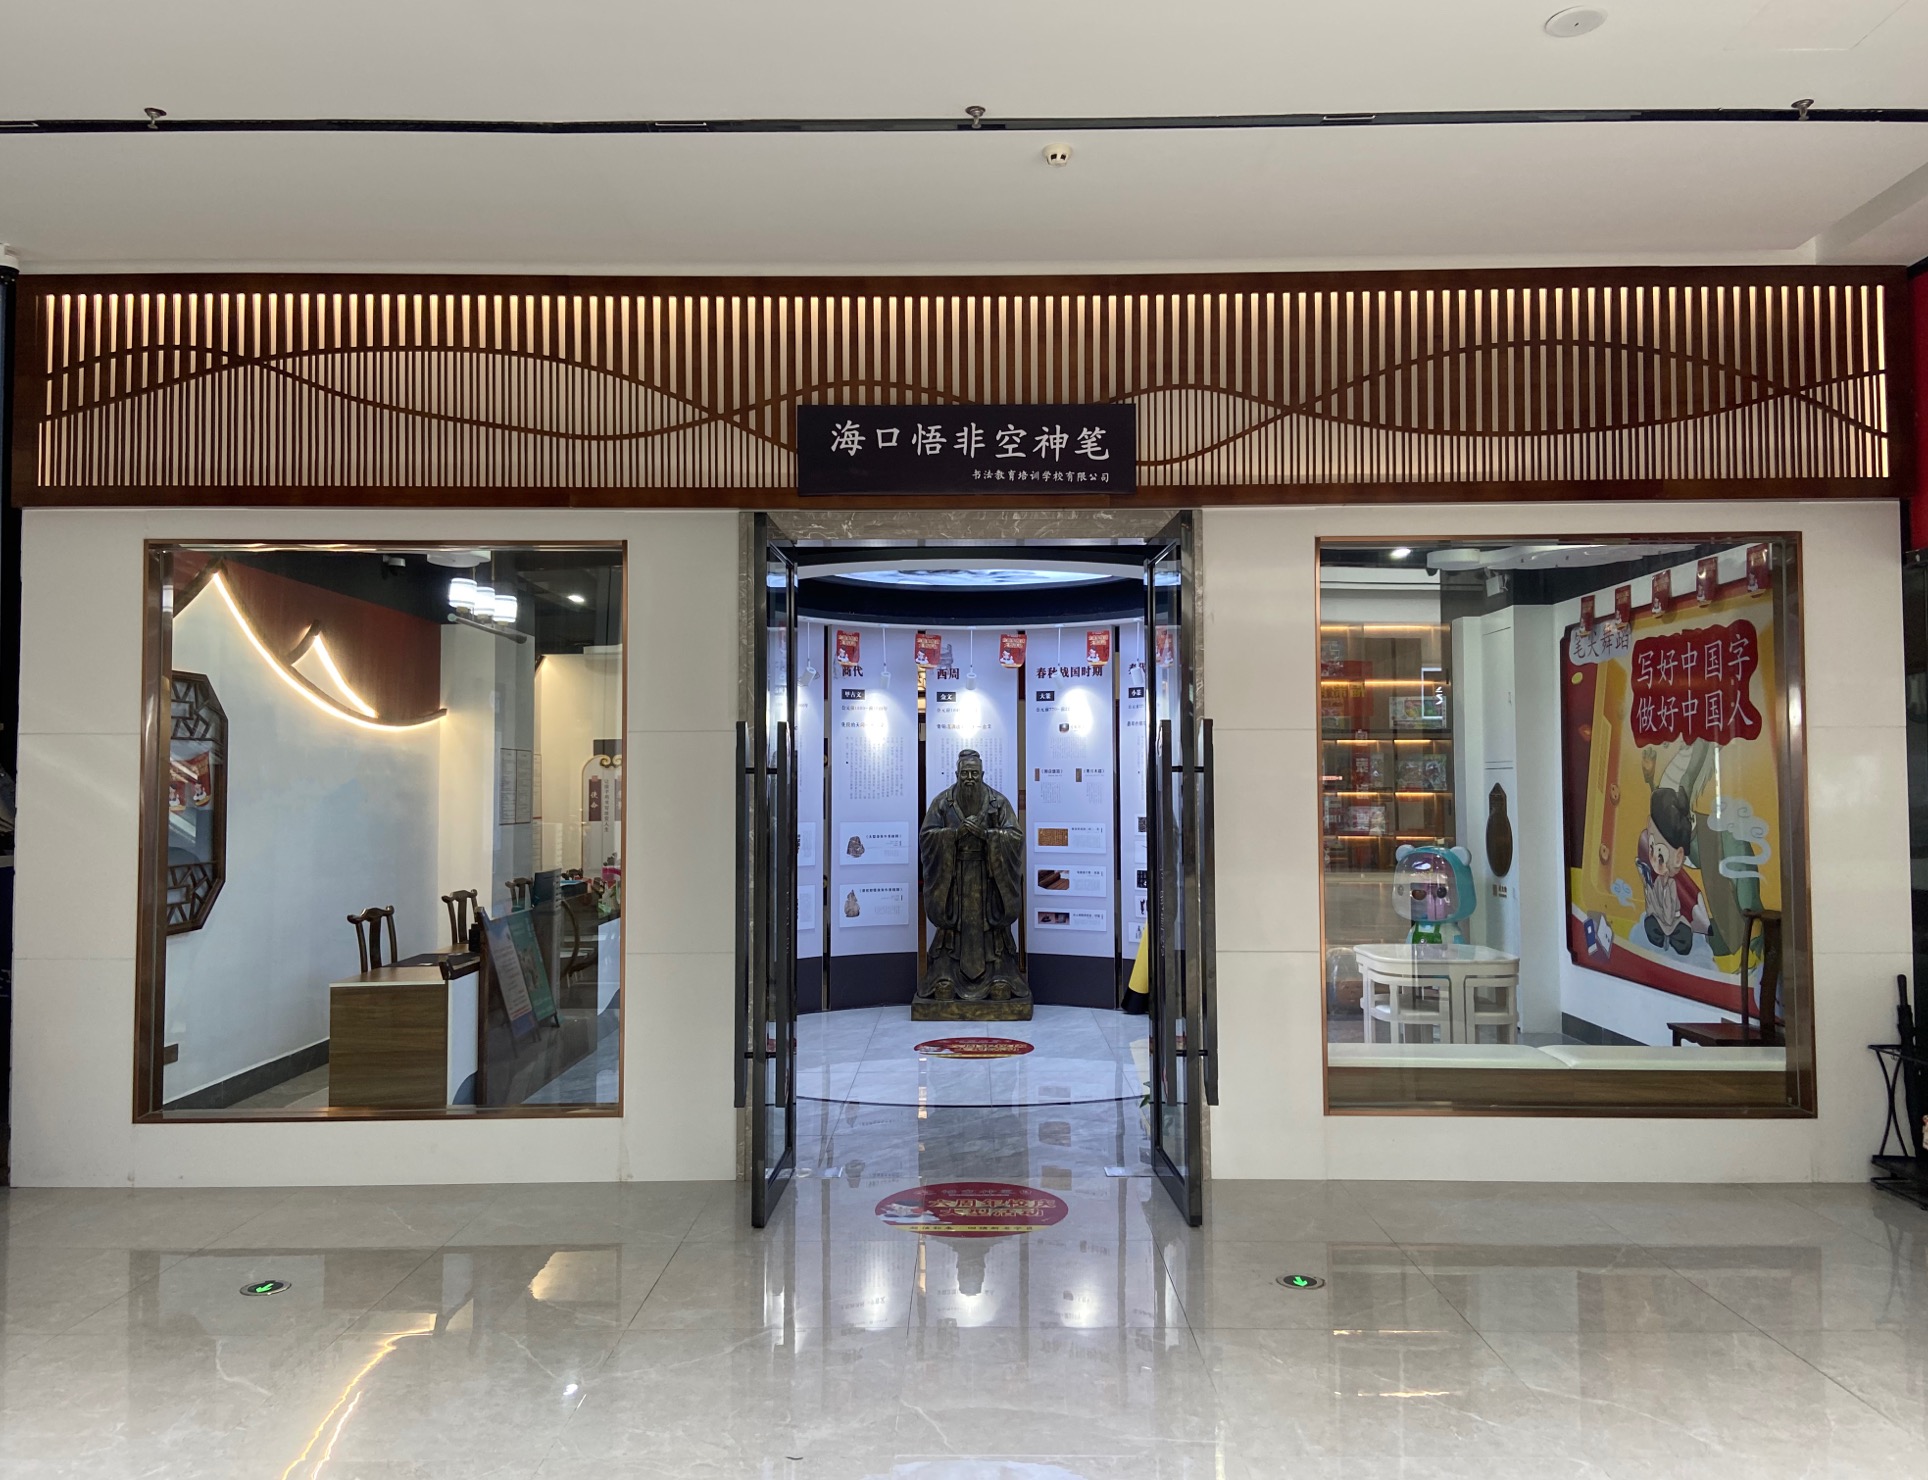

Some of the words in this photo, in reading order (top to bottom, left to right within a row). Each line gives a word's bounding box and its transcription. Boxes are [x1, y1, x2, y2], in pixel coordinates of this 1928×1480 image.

[830, 419, 1110, 462] 海口悟非空神笔
[972, 469, 1110, 483] 书法教育培训学校有限公司
[937, 668, 959, 680] 西周
[1036, 665, 1103, 678] 春秋战国时期
[1637, 633, 1750, 689] 写好中国字
[1636, 690, 1753, 735] 做好中国人
